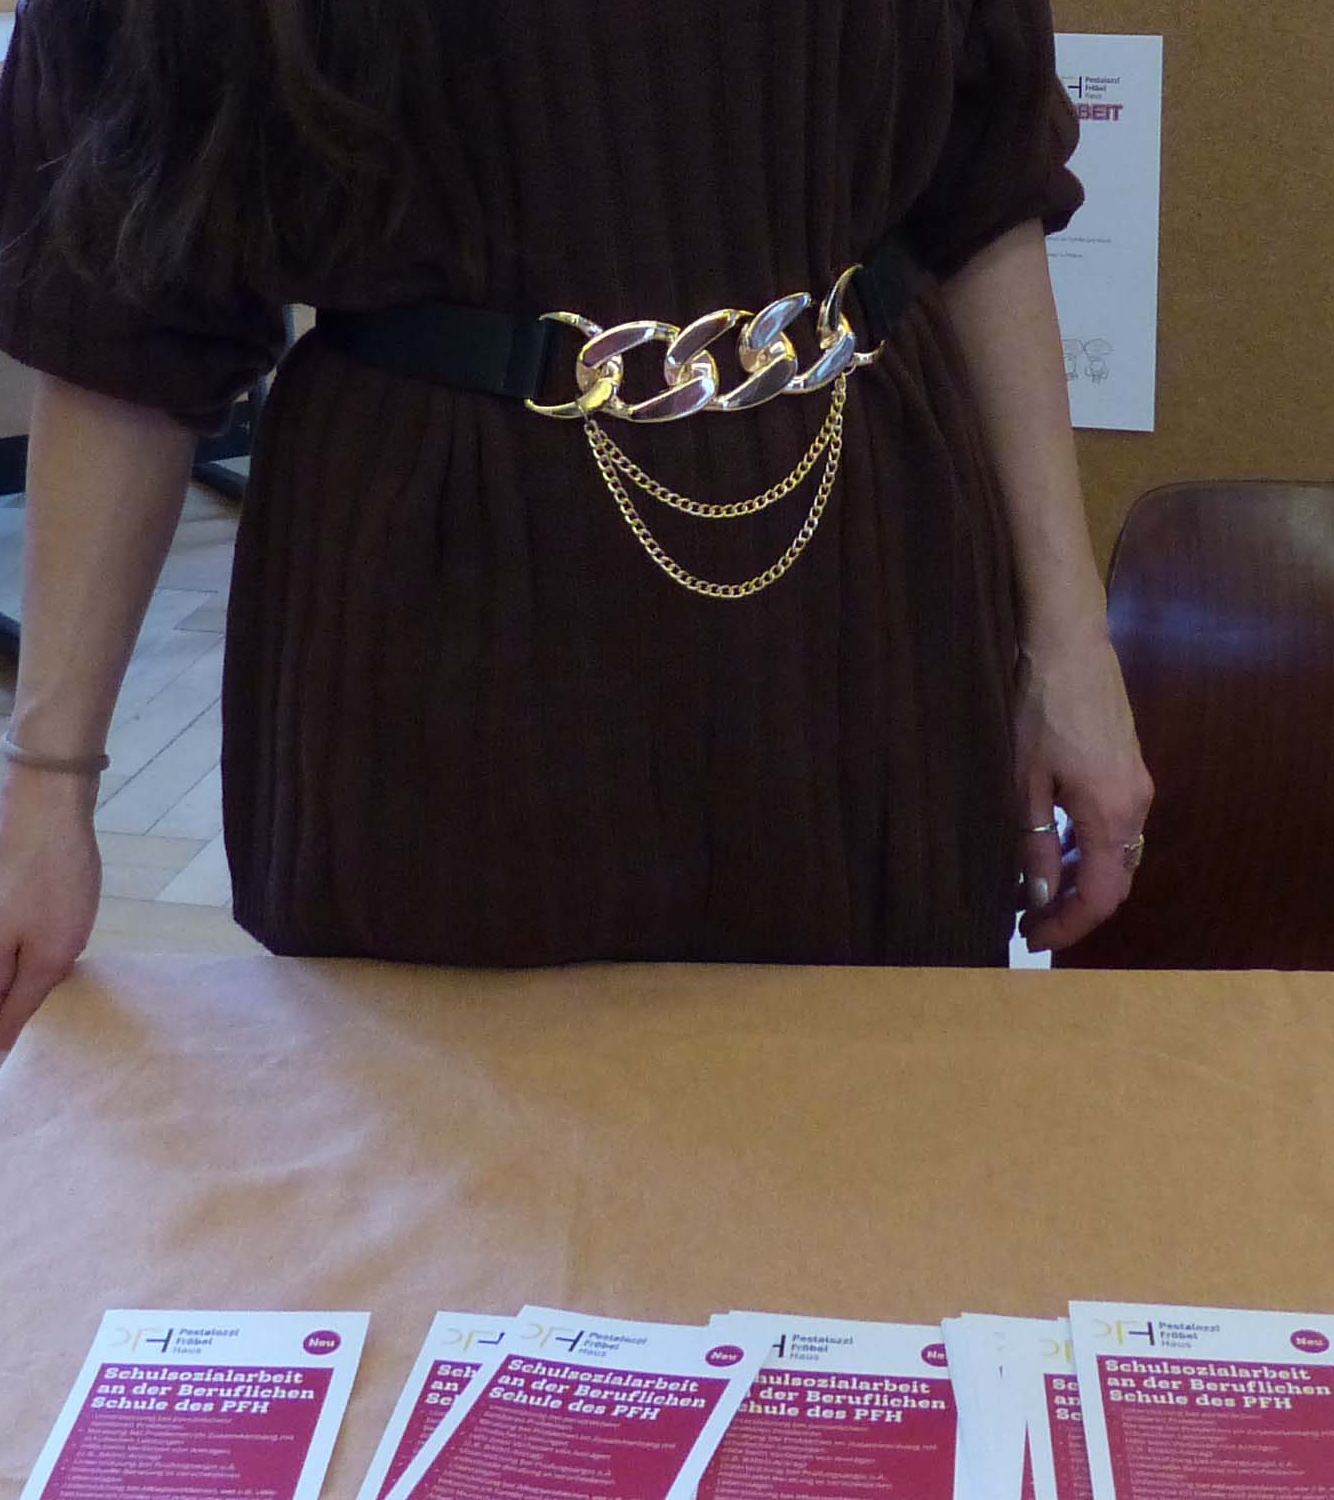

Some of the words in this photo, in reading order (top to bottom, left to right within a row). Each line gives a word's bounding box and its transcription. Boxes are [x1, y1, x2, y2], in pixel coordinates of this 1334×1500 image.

[309, 1338, 335, 1348] Neu
[1296, 1336, 1324, 1347] Neu
[711, 1351, 738, 1361] Neu
[104, 1368, 304, 1384] Schulsozialarbeit
[507, 1359, 699, 1393] Schulsozialarbeit
[1105, 1360, 1311, 1380] Schulsozialarbeit
[97, 1384, 125, 1396] an
[132, 1383, 173, 1397] der
[177, 1384, 316, 1400] Beruflichen
[497, 1374, 526, 1387] an
[531, 1378, 570, 1395] der
[575, 1383, 706, 1409] Beruflichen
[1107, 1376, 1140, 1389] an
[1146, 1377, 1186, 1391] der
[1189, 1378, 1331, 1396] Beruflichen
[91, 1398, 168, 1411] Schule
[174, 1399, 215, 1412] des
[221, 1399, 269, 1414] PFH
[488, 1387, 563, 1409] Schule
[568, 1400, 605, 1416] des
[611, 1404, 660, 1421] PFH
[762, 1387, 801, 1402] der
[806, 1389, 947, 1411] Beruflichen
[1110, 1390, 1188, 1405] Schule
[1196, 1394, 1237, 1406] des
[1243, 1396, 1292, 1410] PFH
[807, 1405, 845, 1419] des
[854, 1408, 903, 1423] PFH
